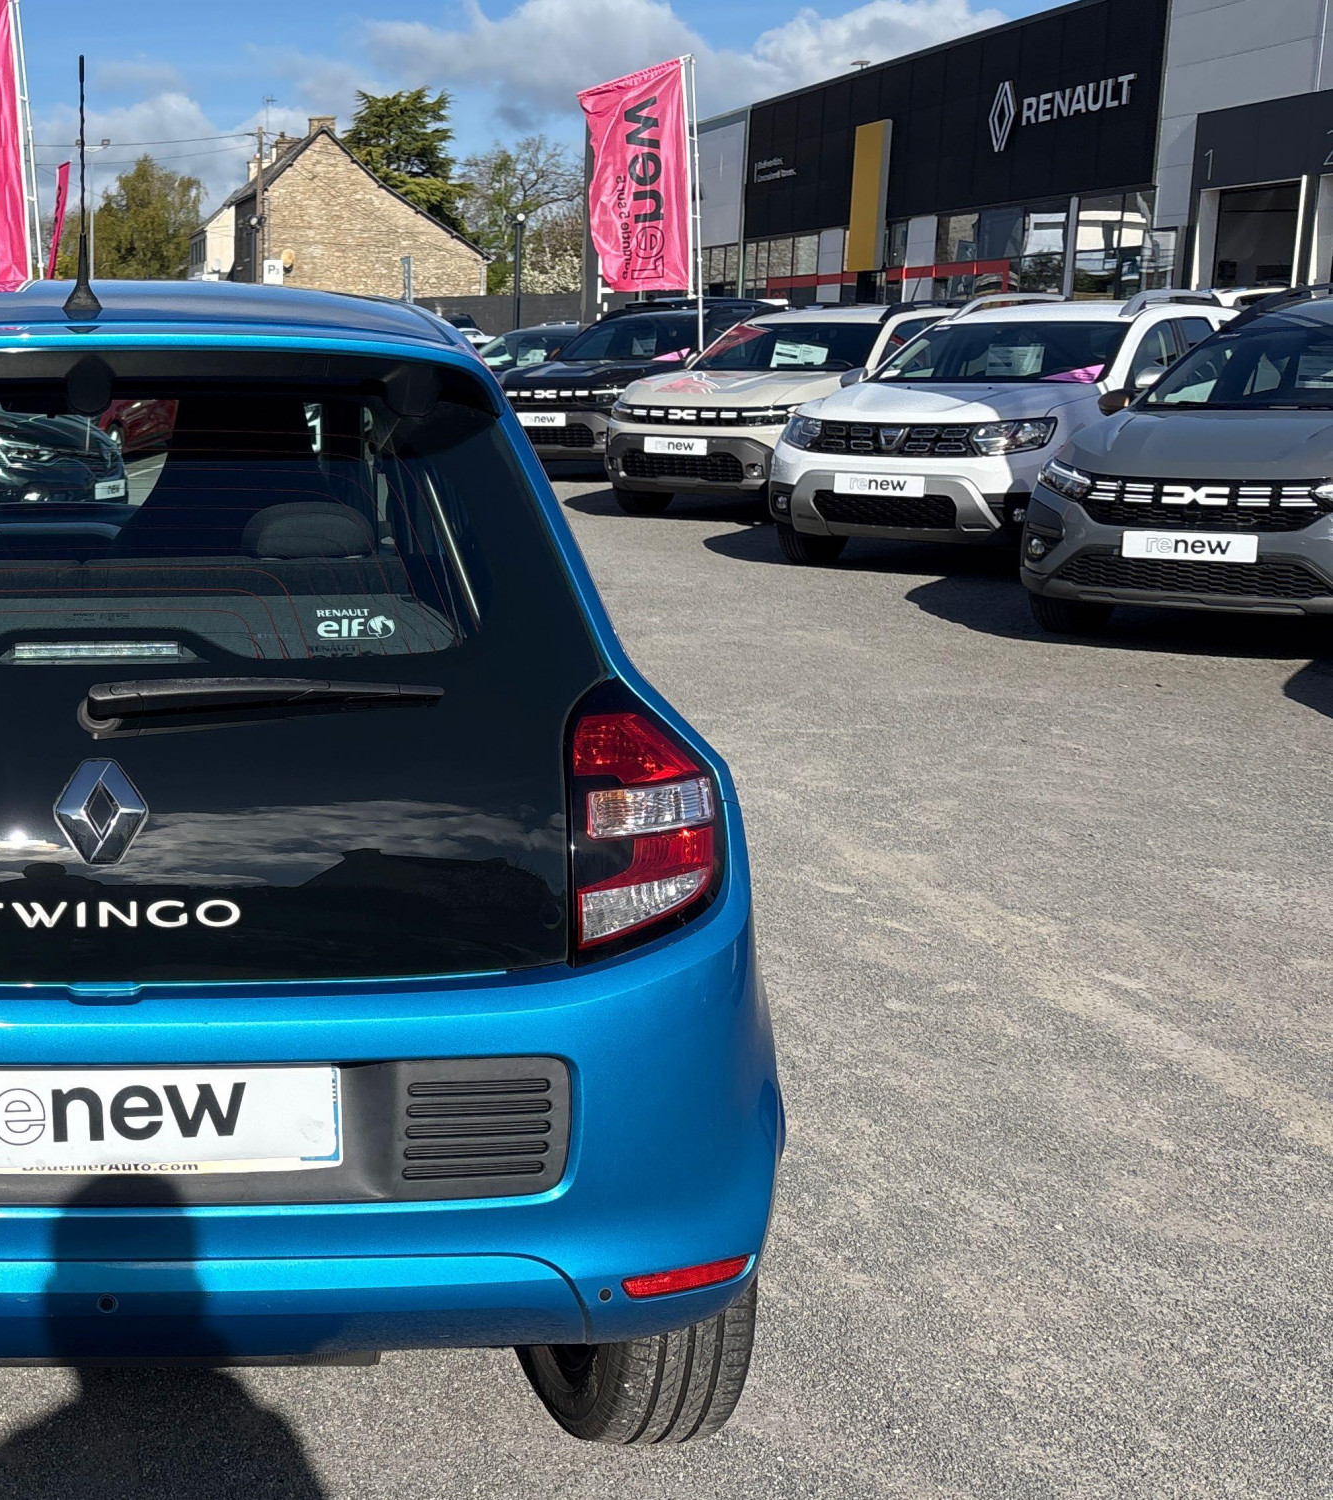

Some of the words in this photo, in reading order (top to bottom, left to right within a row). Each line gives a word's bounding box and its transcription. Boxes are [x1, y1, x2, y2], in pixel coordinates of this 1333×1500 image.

[1021, 73, 1138, 126] RENAULT
[1204, 149, 1214, 181] 1
[849, 477, 907, 491] renew
[1145, 537, 1232, 555] renew
[316, 608, 370, 618] RENAULT
[317, 618, 365, 638] elf
